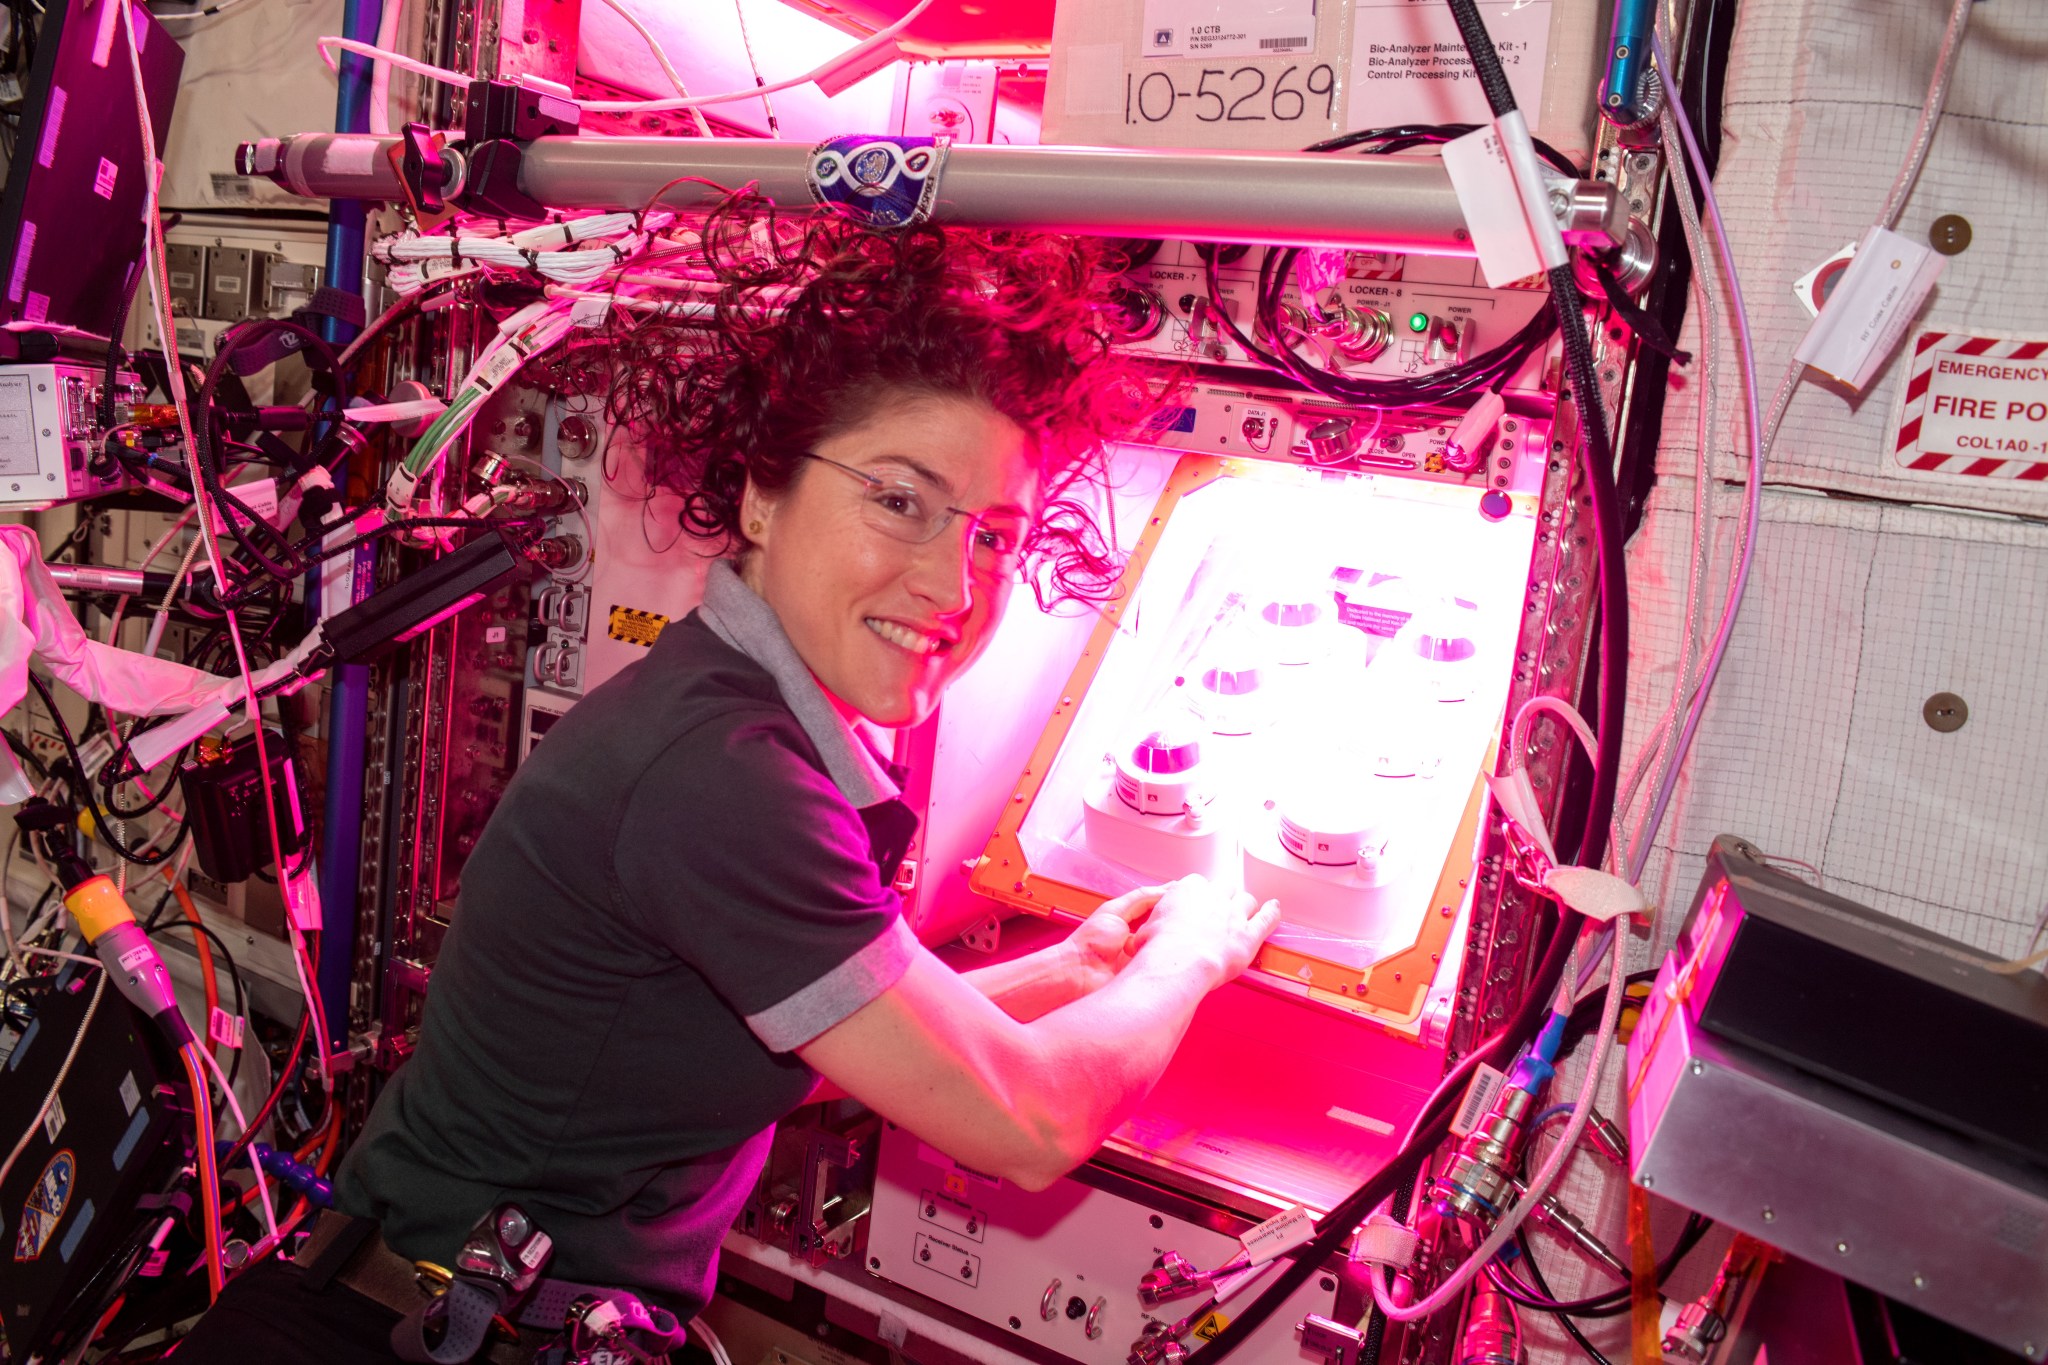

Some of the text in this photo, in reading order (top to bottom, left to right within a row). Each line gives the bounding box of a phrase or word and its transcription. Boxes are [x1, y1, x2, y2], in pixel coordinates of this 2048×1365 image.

[1204, 25, 1221, 34] CTB
[1370, 44, 1431, 53] Bio-Analyzer
[1433, 43, 1496, 52] Maintee
[1499, 42, 1513, 51] Kit
[1523, 42, 1528, 50] 1
[1368, 57, 1430, 66] Bio-Analyzer
[1432, 56, 1474, 66] Process
[1513, 56, 1520, 64] 2
[1367, 69, 1477, 80] Control Processing Kit
[1149, 271, 1184, 281] LOCKER
[1349, 285, 1389, 296] LOCKER
[1397, 289, 1403, 297] 8
[1448, 306, 1472, 314] POWER
[1404, 362, 1418, 374] J2
[1937, 359, 2048, 381] EMERGENCY
[1933, 395, 1997, 420] FIRE
[1956, 435, 2029, 452] COL1A0
[625, 612, 654, 627] WARNING
[1196, 1141, 1231, 1155] FRONT
[952, 1244, 969, 1256] Status
[1141, 1312, 1172, 1328] RF Outpu
